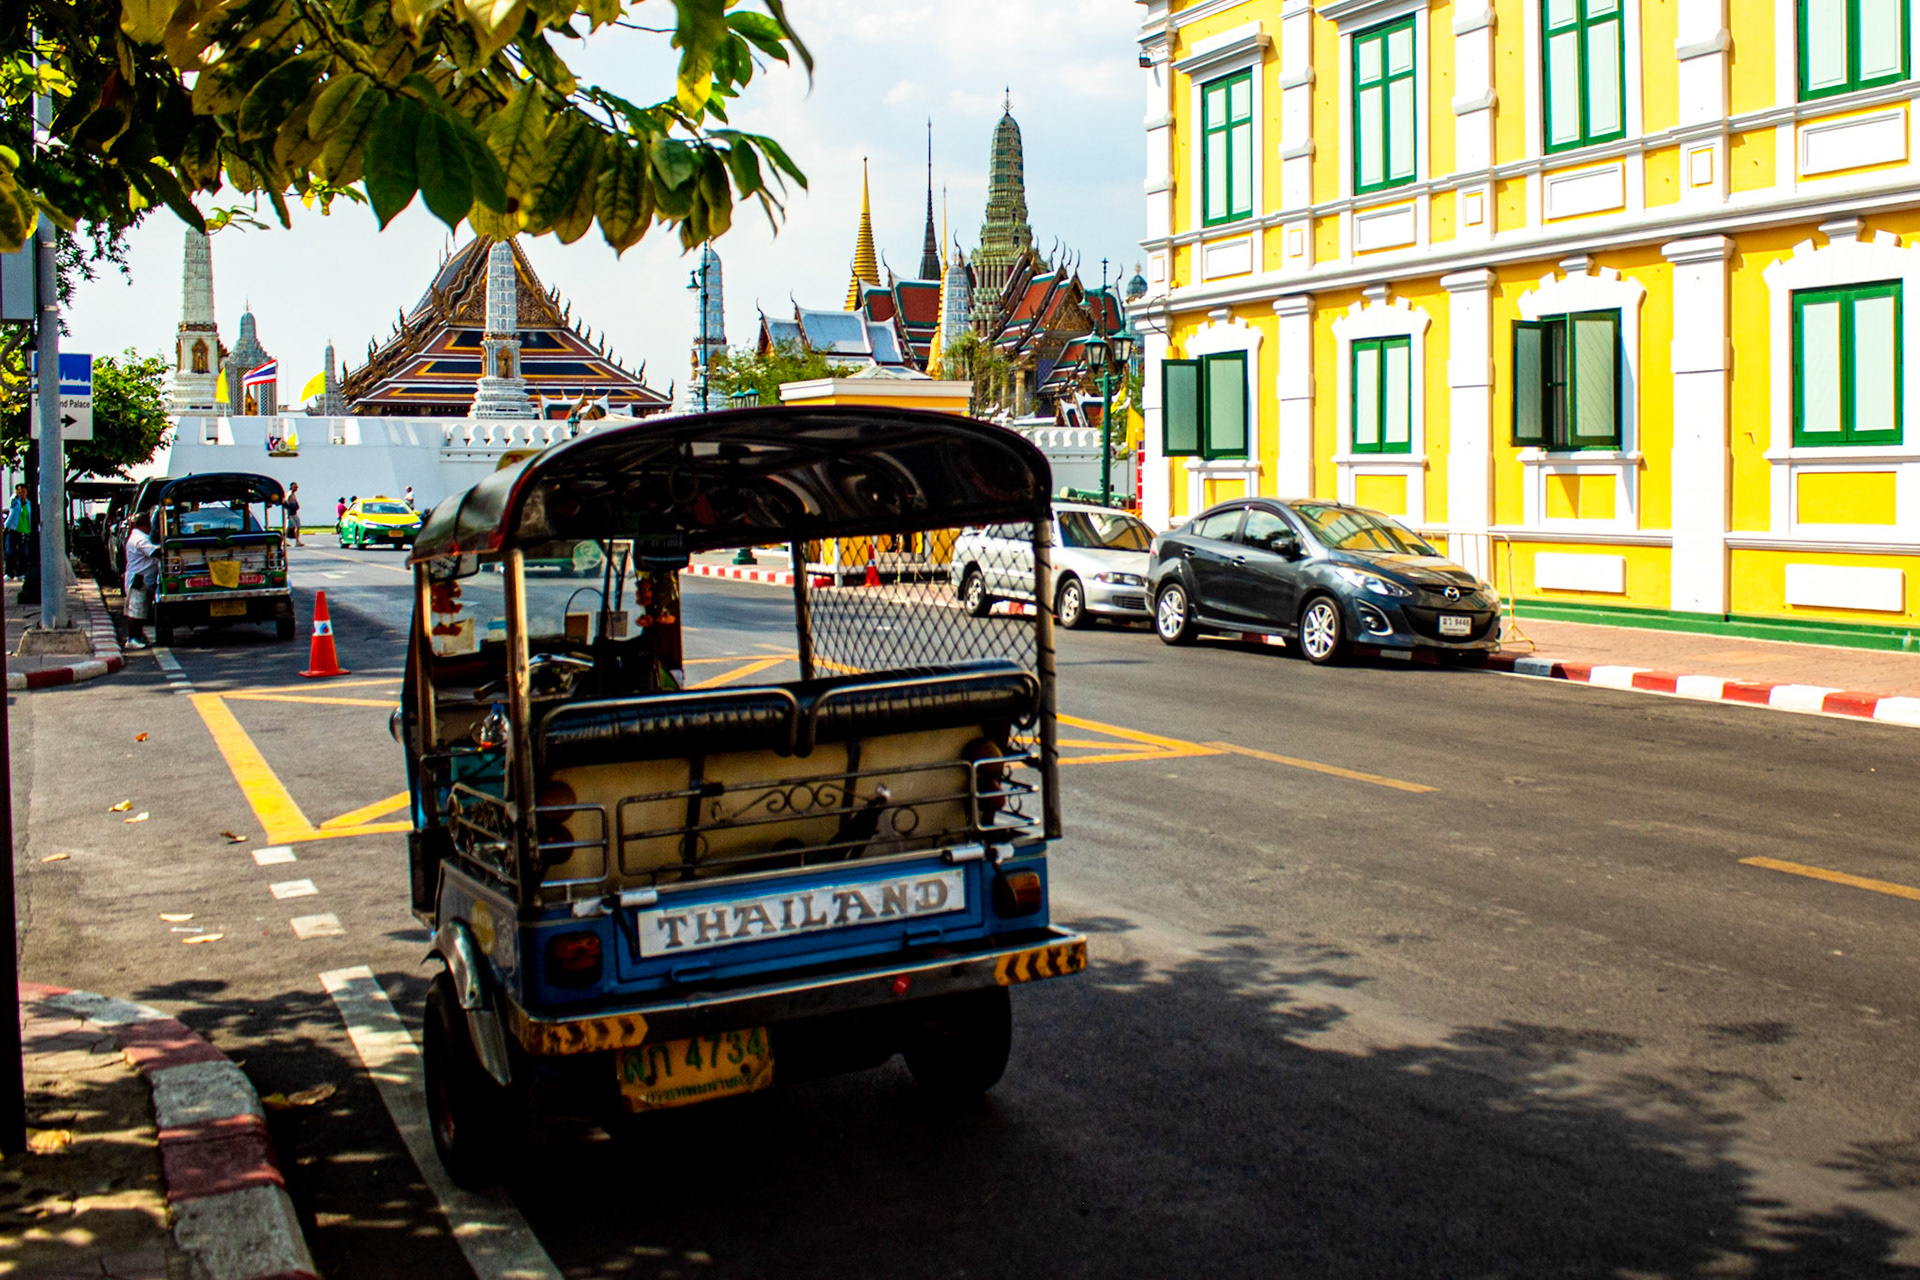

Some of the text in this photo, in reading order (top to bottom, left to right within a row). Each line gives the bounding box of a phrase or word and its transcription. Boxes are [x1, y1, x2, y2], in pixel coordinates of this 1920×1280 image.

[69, 399, 90, 408] Palace
[657, 878, 949, 949] THAILAND
[686, 1026, 767, 1072] 4734
